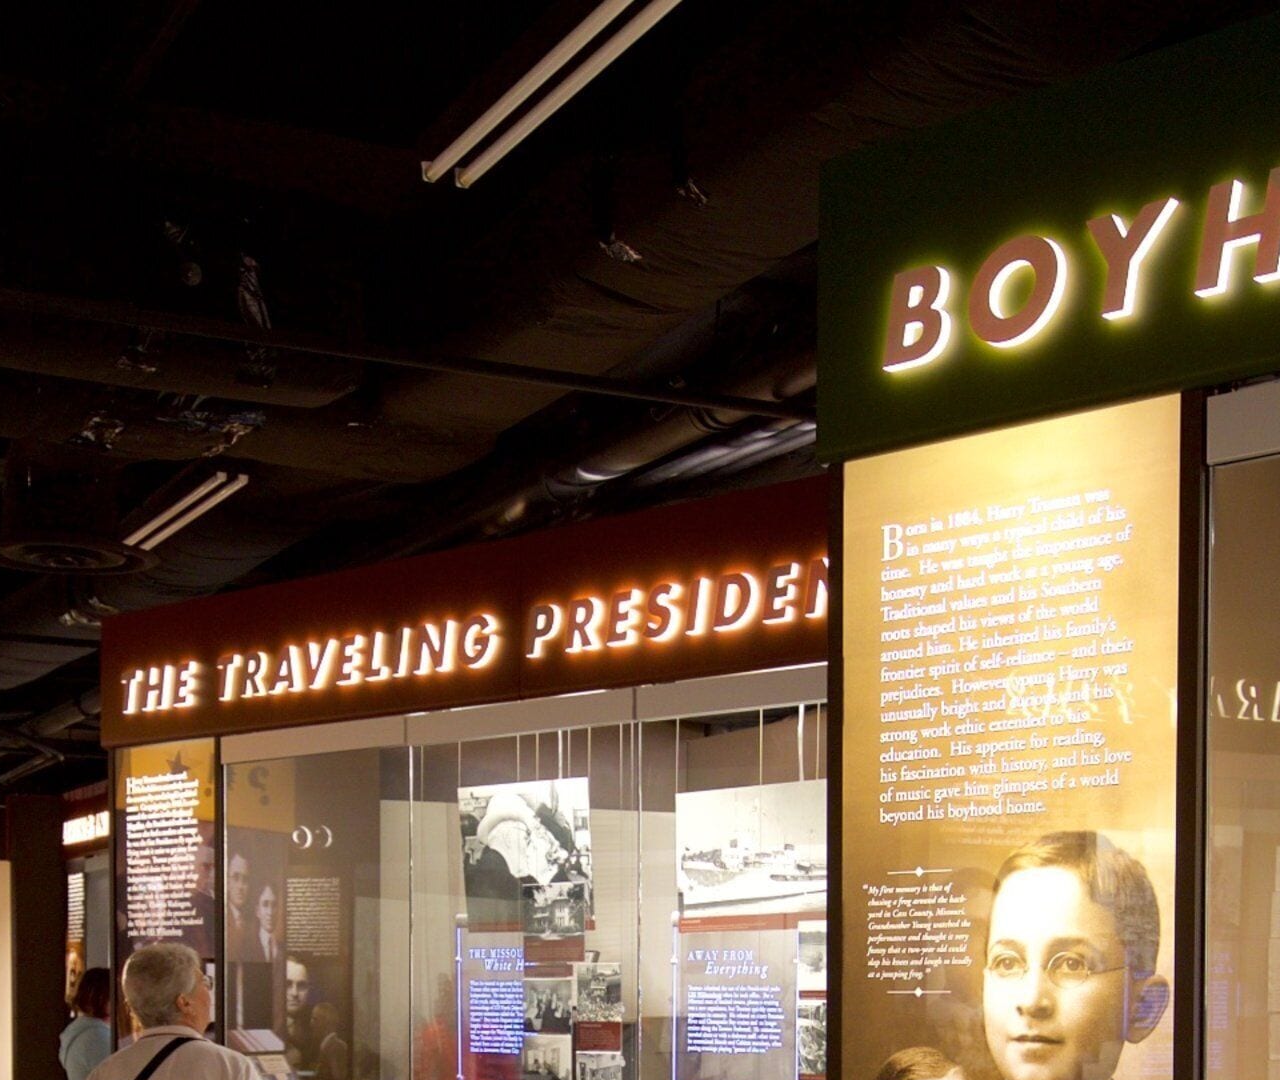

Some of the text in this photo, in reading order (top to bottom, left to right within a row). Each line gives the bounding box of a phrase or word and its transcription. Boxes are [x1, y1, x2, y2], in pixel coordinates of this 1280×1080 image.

[122, 661, 200, 715] THE
[217, 613, 502, 702] TRAVELING
[880, 748, 1132, 782] his fascination with history, and his love
[880, 771, 1120, 802] of music gave him glimpses of a world
[469, 948, 486, 959] THE
[484, 957, 512, 971] White
[688, 950, 753, 961] AWAY FROM
[704, 959, 769, 980] Everything
